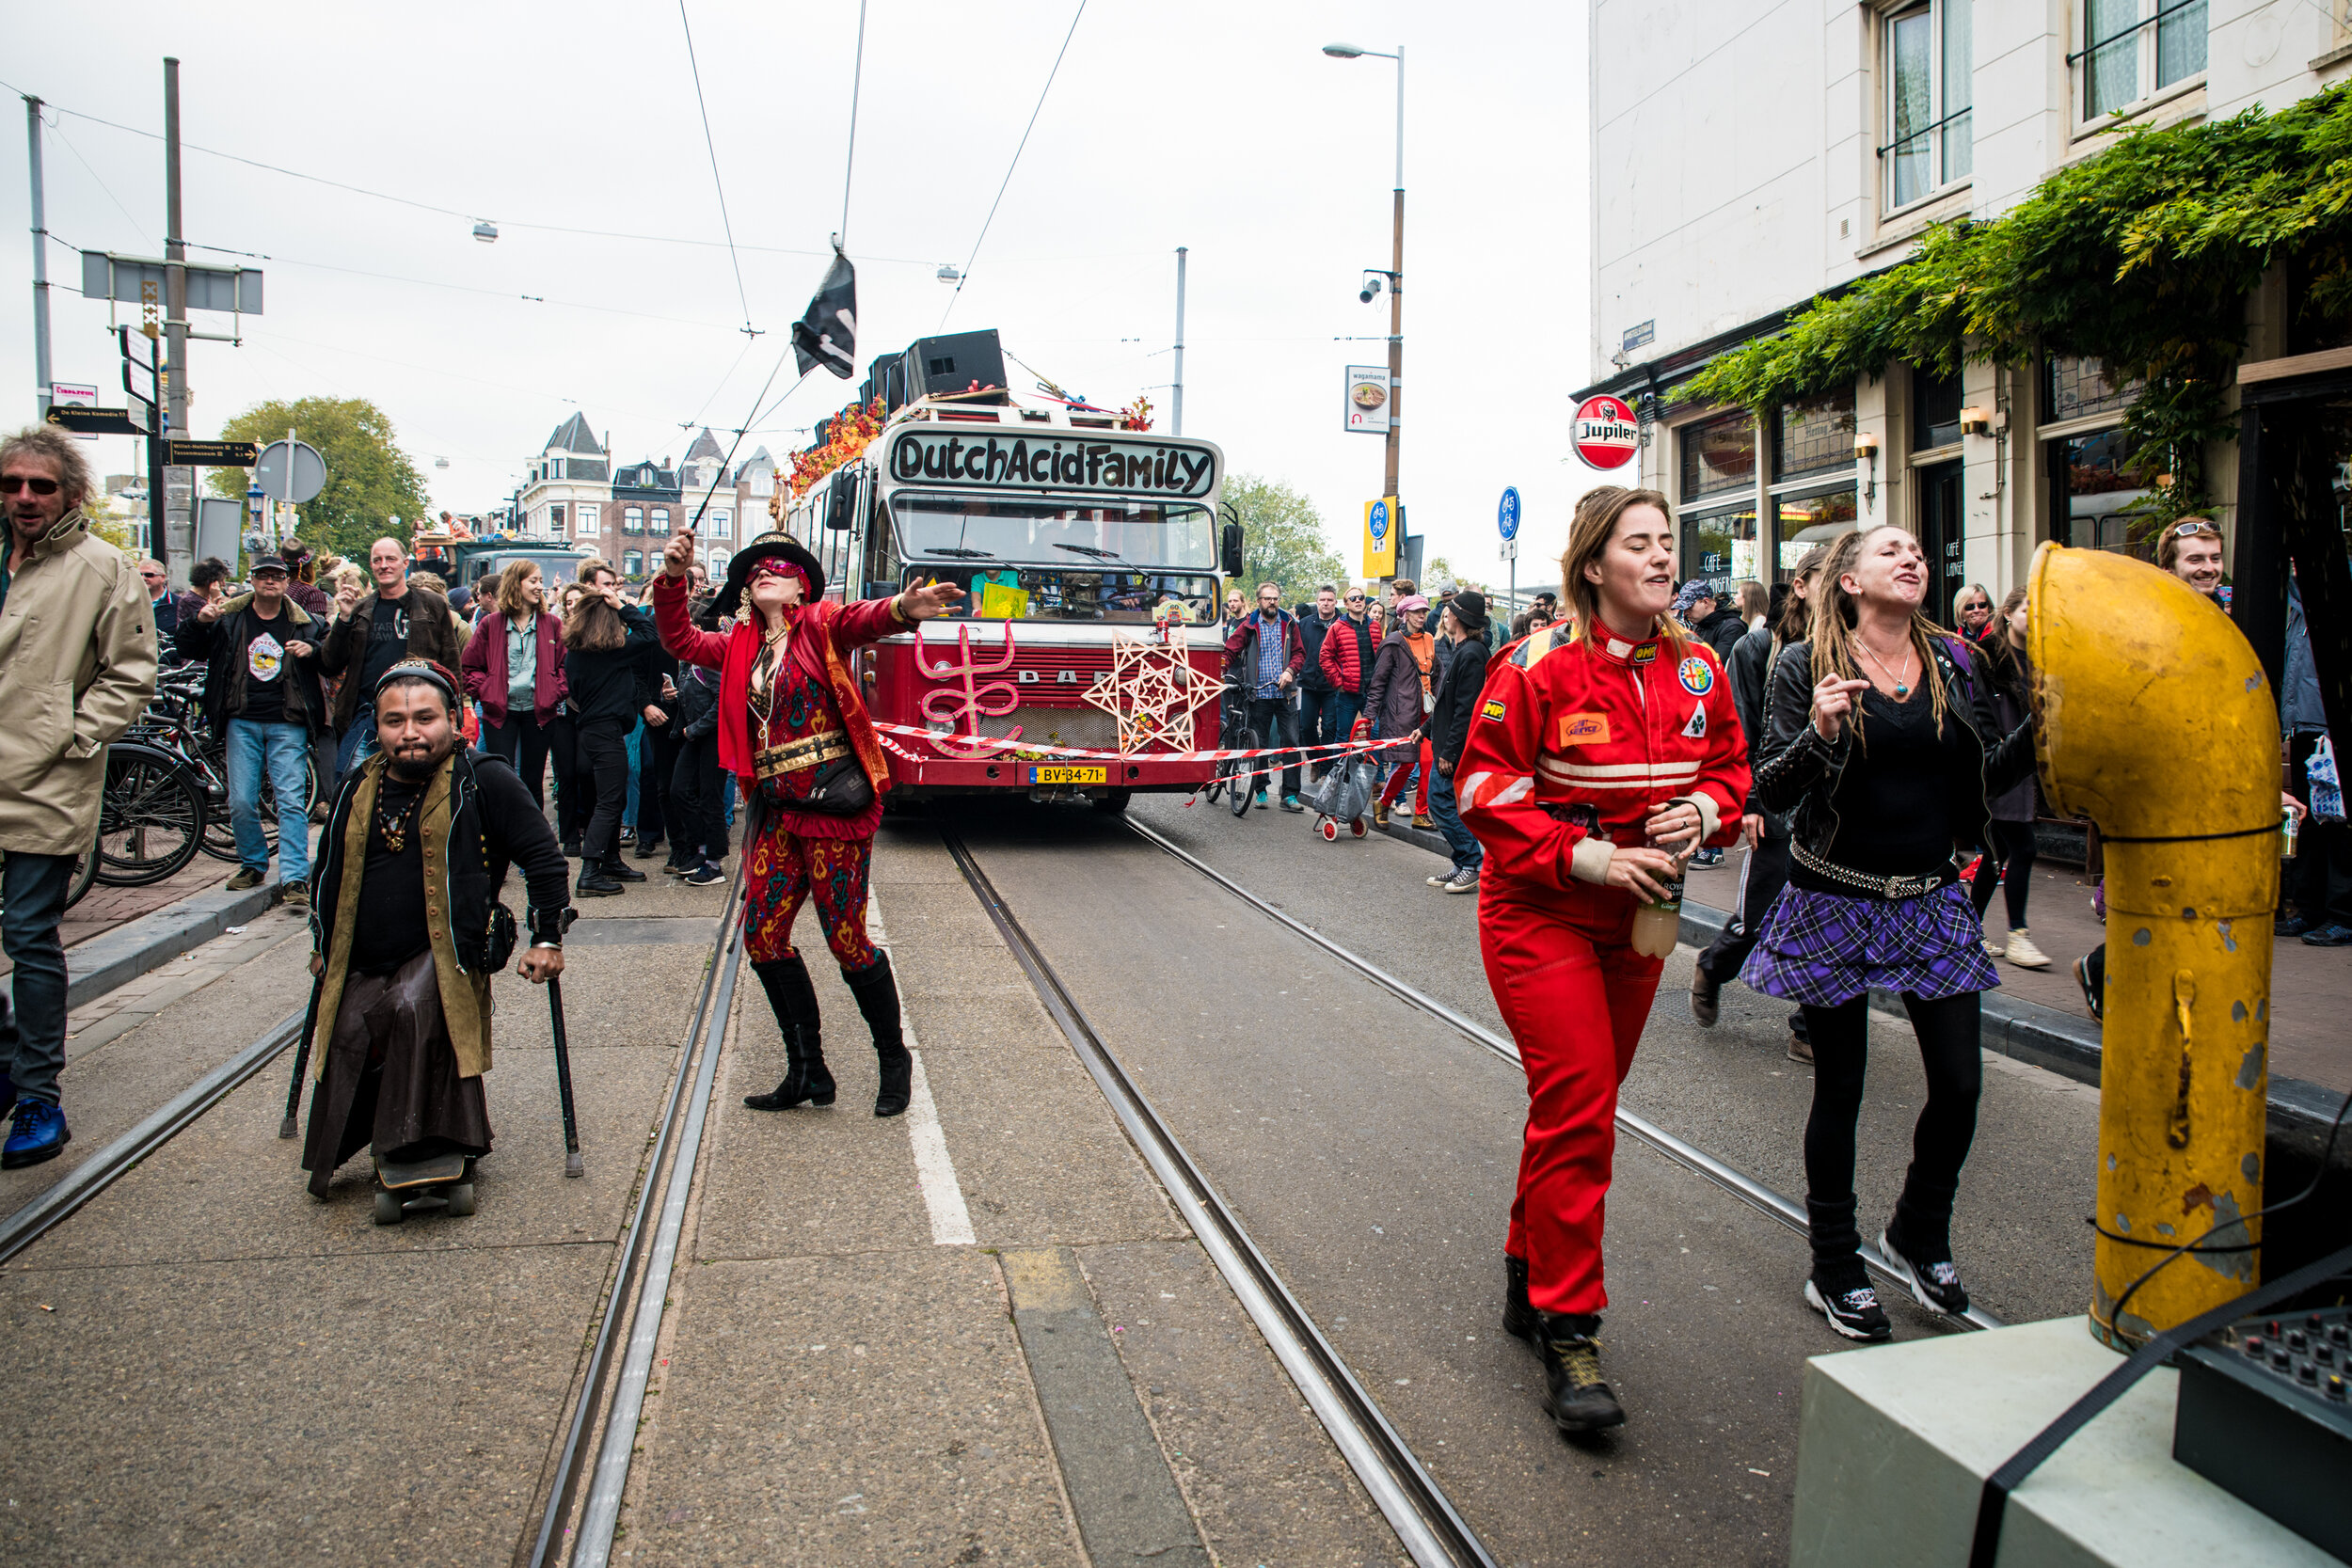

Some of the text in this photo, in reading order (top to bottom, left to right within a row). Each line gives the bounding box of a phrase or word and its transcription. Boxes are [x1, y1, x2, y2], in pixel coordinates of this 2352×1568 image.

[1579, 421, 1637, 442] Jupiler
[1947, 538, 1960, 557] CAFÉ
[1704, 549, 1722, 573] CAFÉ
[373, 622, 393, 631] TAR
[1635, 646, 1656, 658] OMP
[1483, 703, 1504, 718] MP
[1044, 768, 1099, 781] BV-34-71
